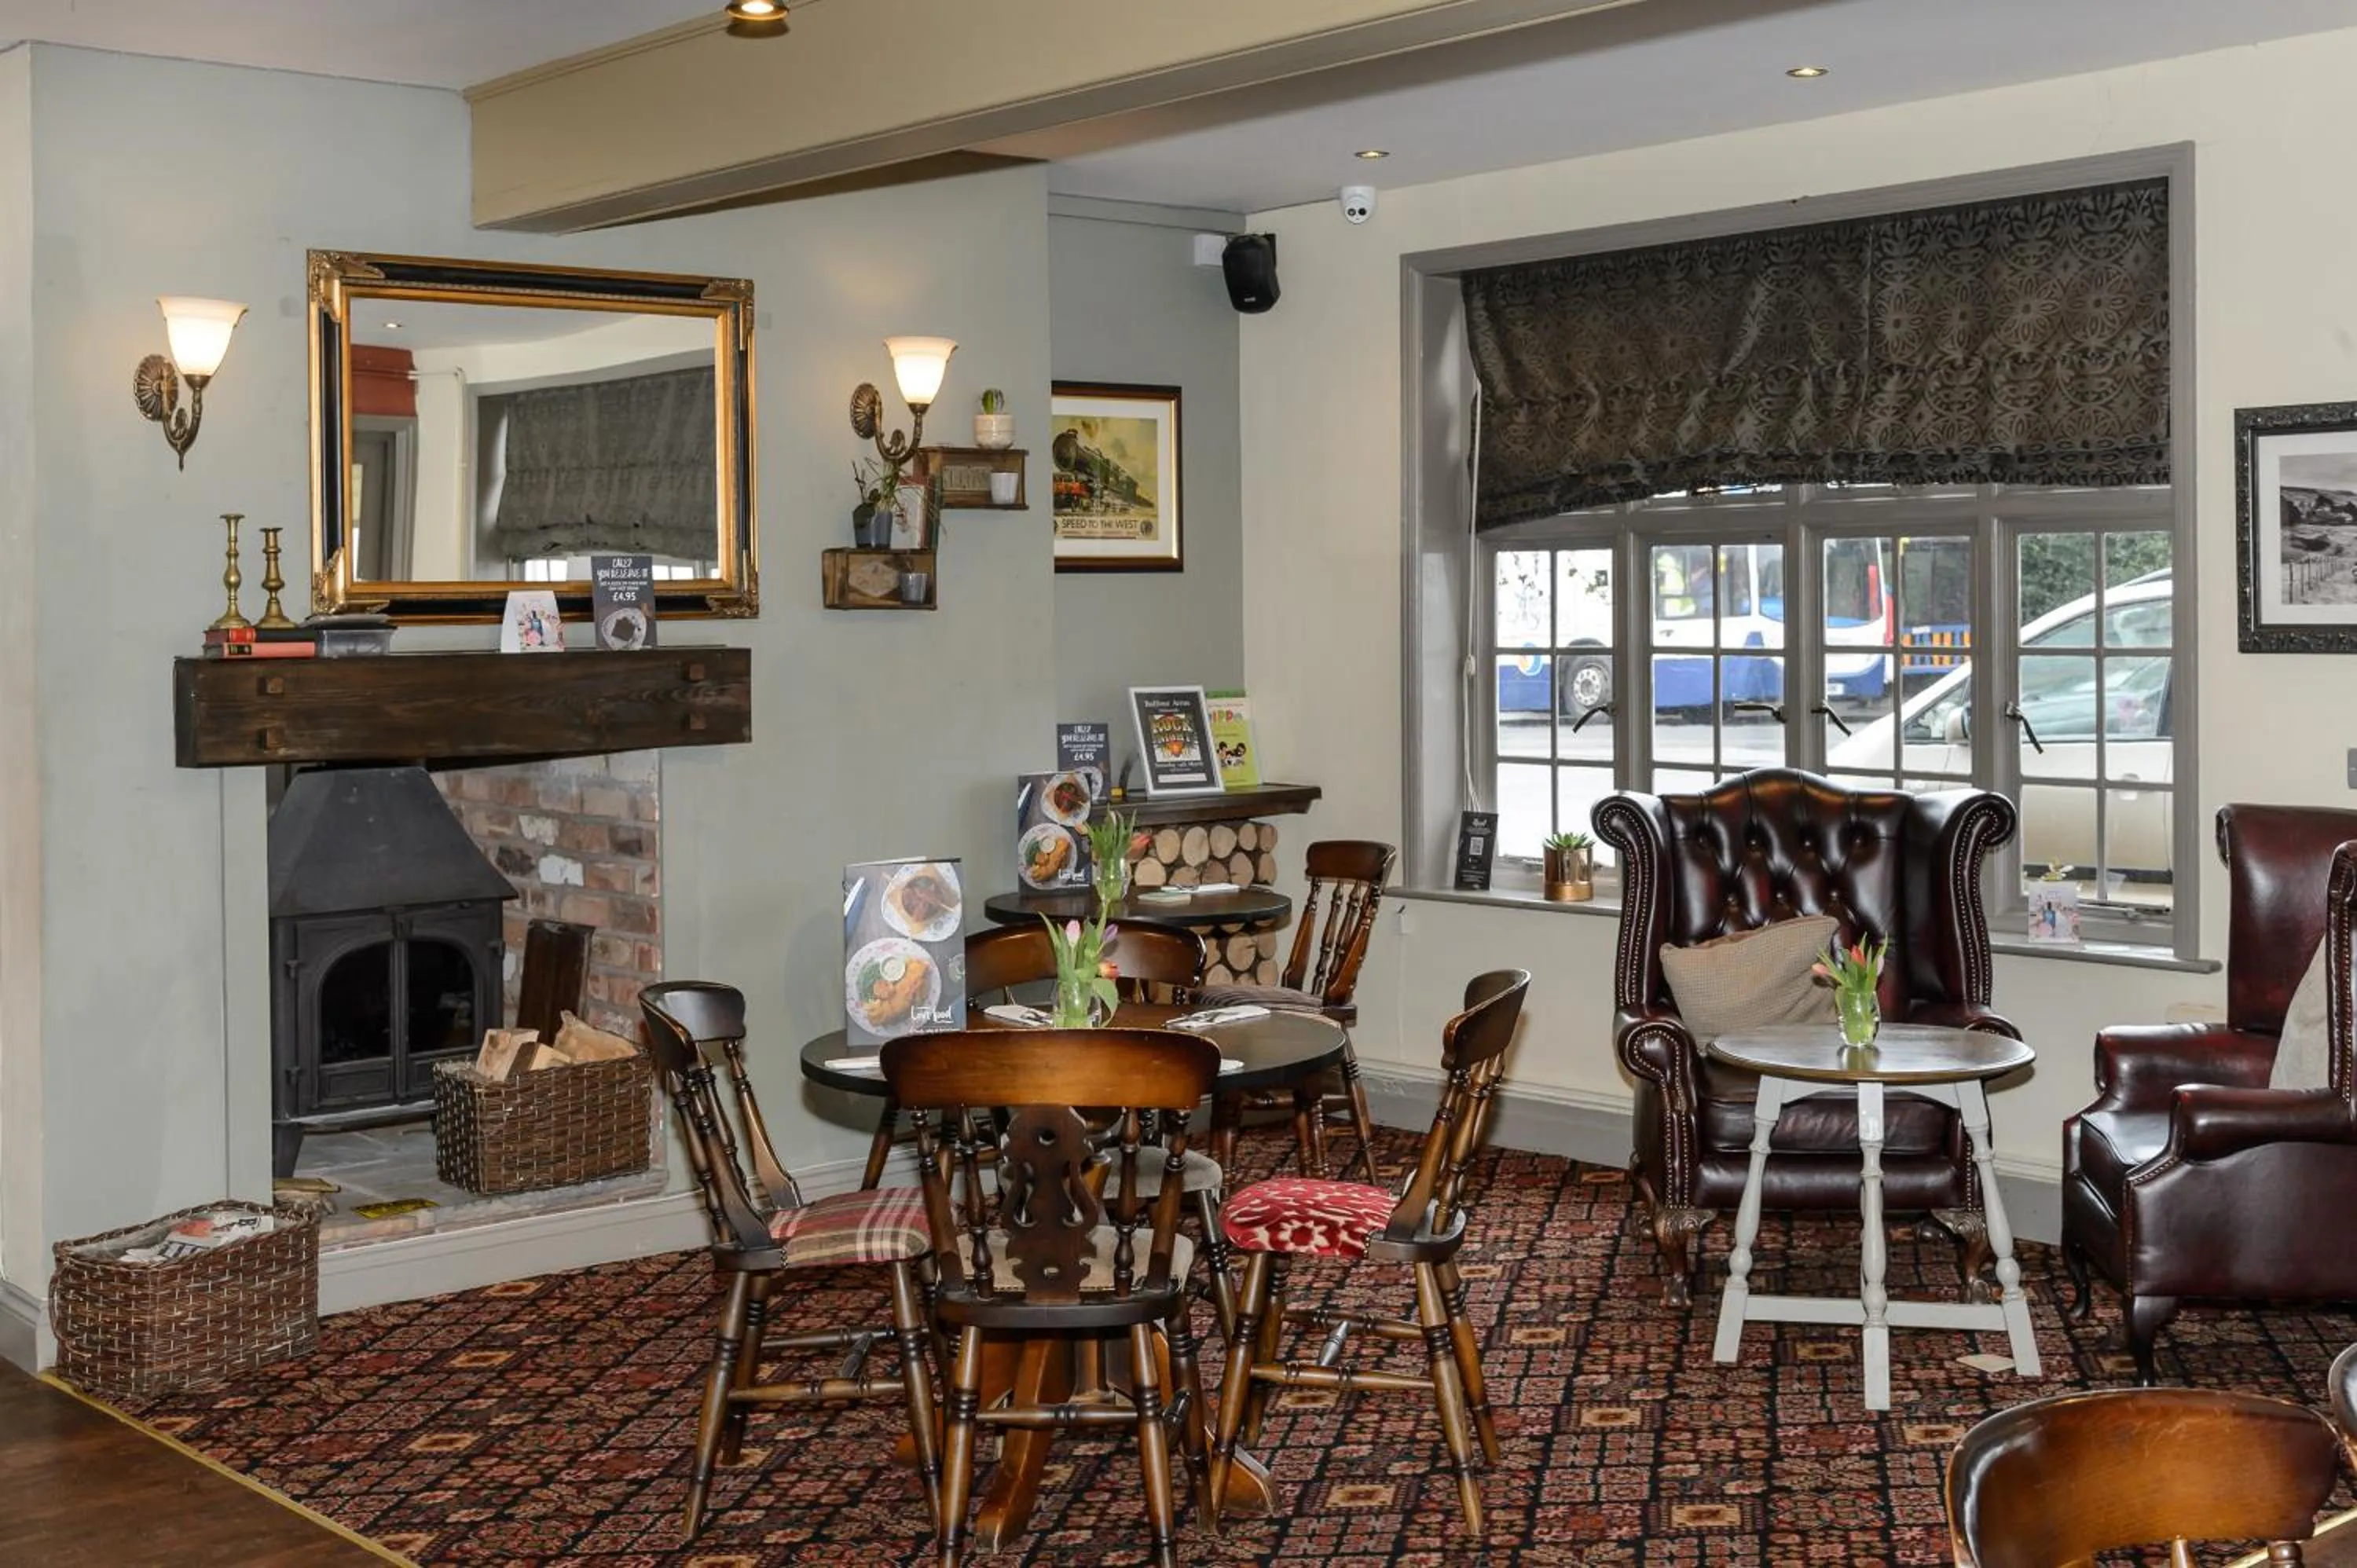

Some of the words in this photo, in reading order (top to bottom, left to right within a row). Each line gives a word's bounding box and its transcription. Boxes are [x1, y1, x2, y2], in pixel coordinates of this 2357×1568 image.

[1061, 518, 1087, 529] SPEED
[1088, 519, 1099, 529] TO
[1100, 519, 1113, 529] THE
[1115, 519, 1138, 529] WEST
[613, 592, 636, 601] £4.95
[1073, 752, 1094, 761] £4.95
